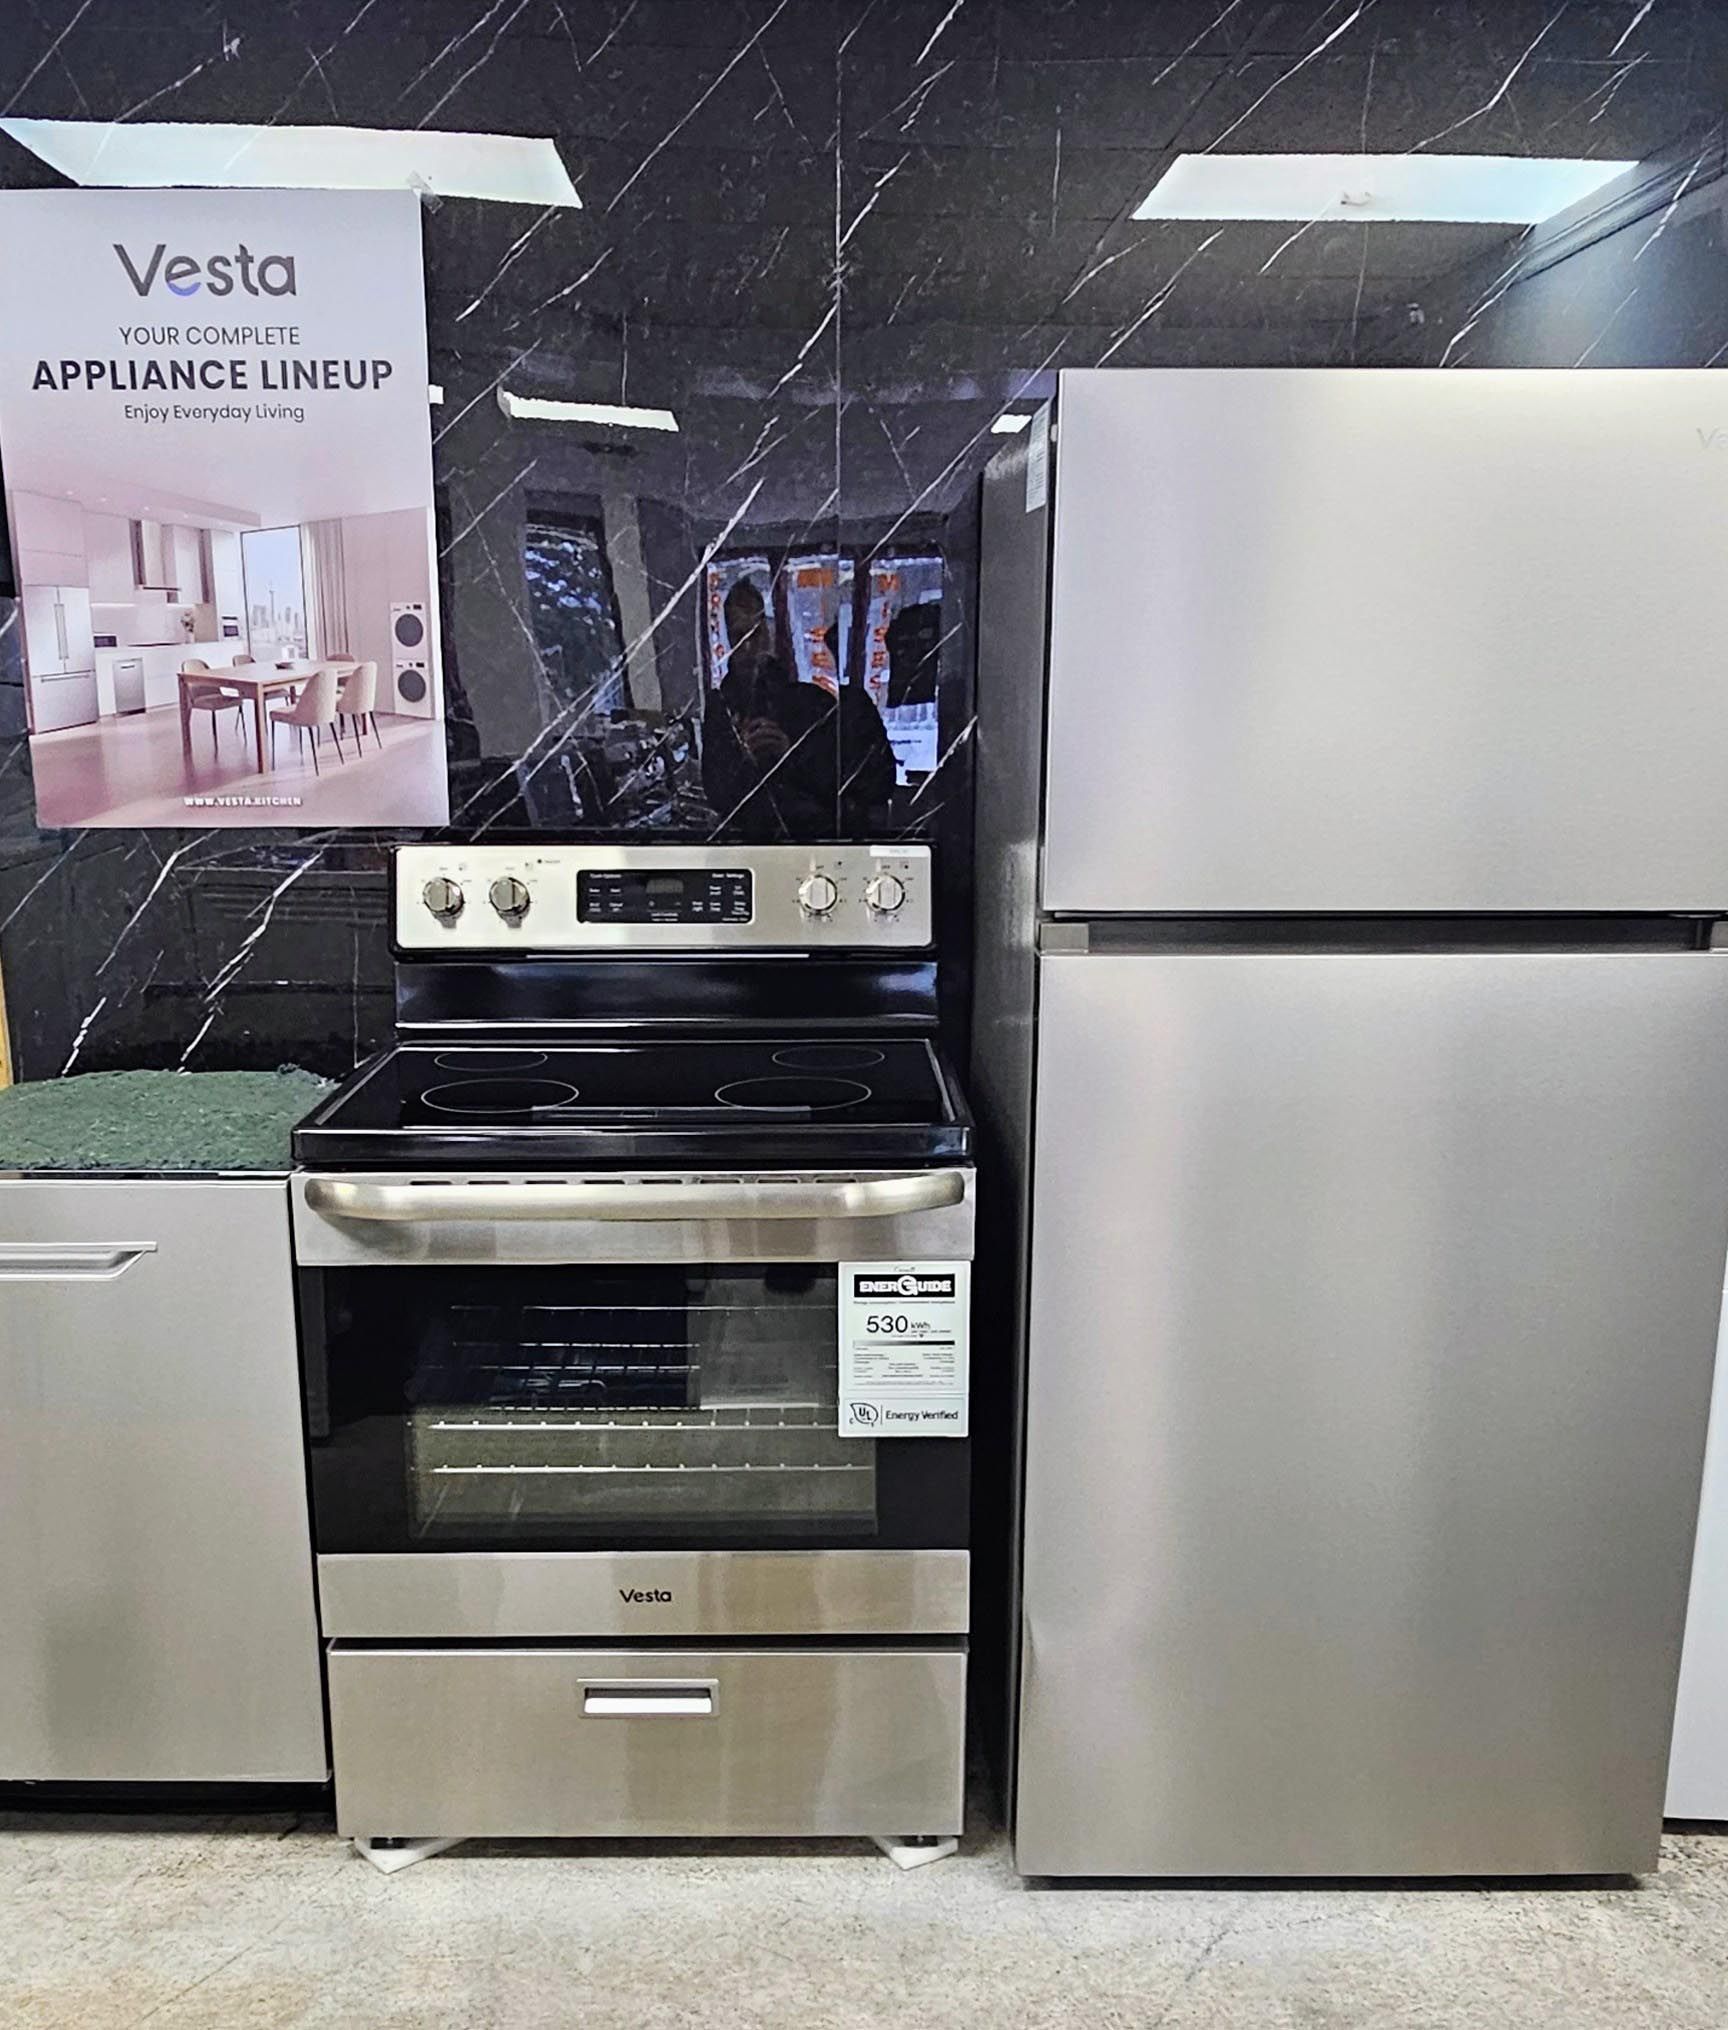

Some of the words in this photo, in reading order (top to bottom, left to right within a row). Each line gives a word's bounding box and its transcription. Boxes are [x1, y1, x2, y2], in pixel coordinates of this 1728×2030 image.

[113, 244, 297, 296] Vesta
[119, 327, 180, 346] YOUR
[186, 326, 300, 346] COMPLETE
[32, 360, 248, 390] APPLIANCE
[261, 360, 392, 390] LINEUP
[125, 405, 169, 423] Enjoy
[174, 404, 251, 423] Everyday
[256, 404, 305, 422] Living
[184, 797, 302, 807] WWW.VESTA.KITCHEN
[866, 1315, 908, 1333] 530
[911, 1322, 931, 1330] kWh
[886, 1410, 919, 1421] Energy
[921, 1410, 959, 1420] Verified
[619, 1589, 672, 1603] Vesta
